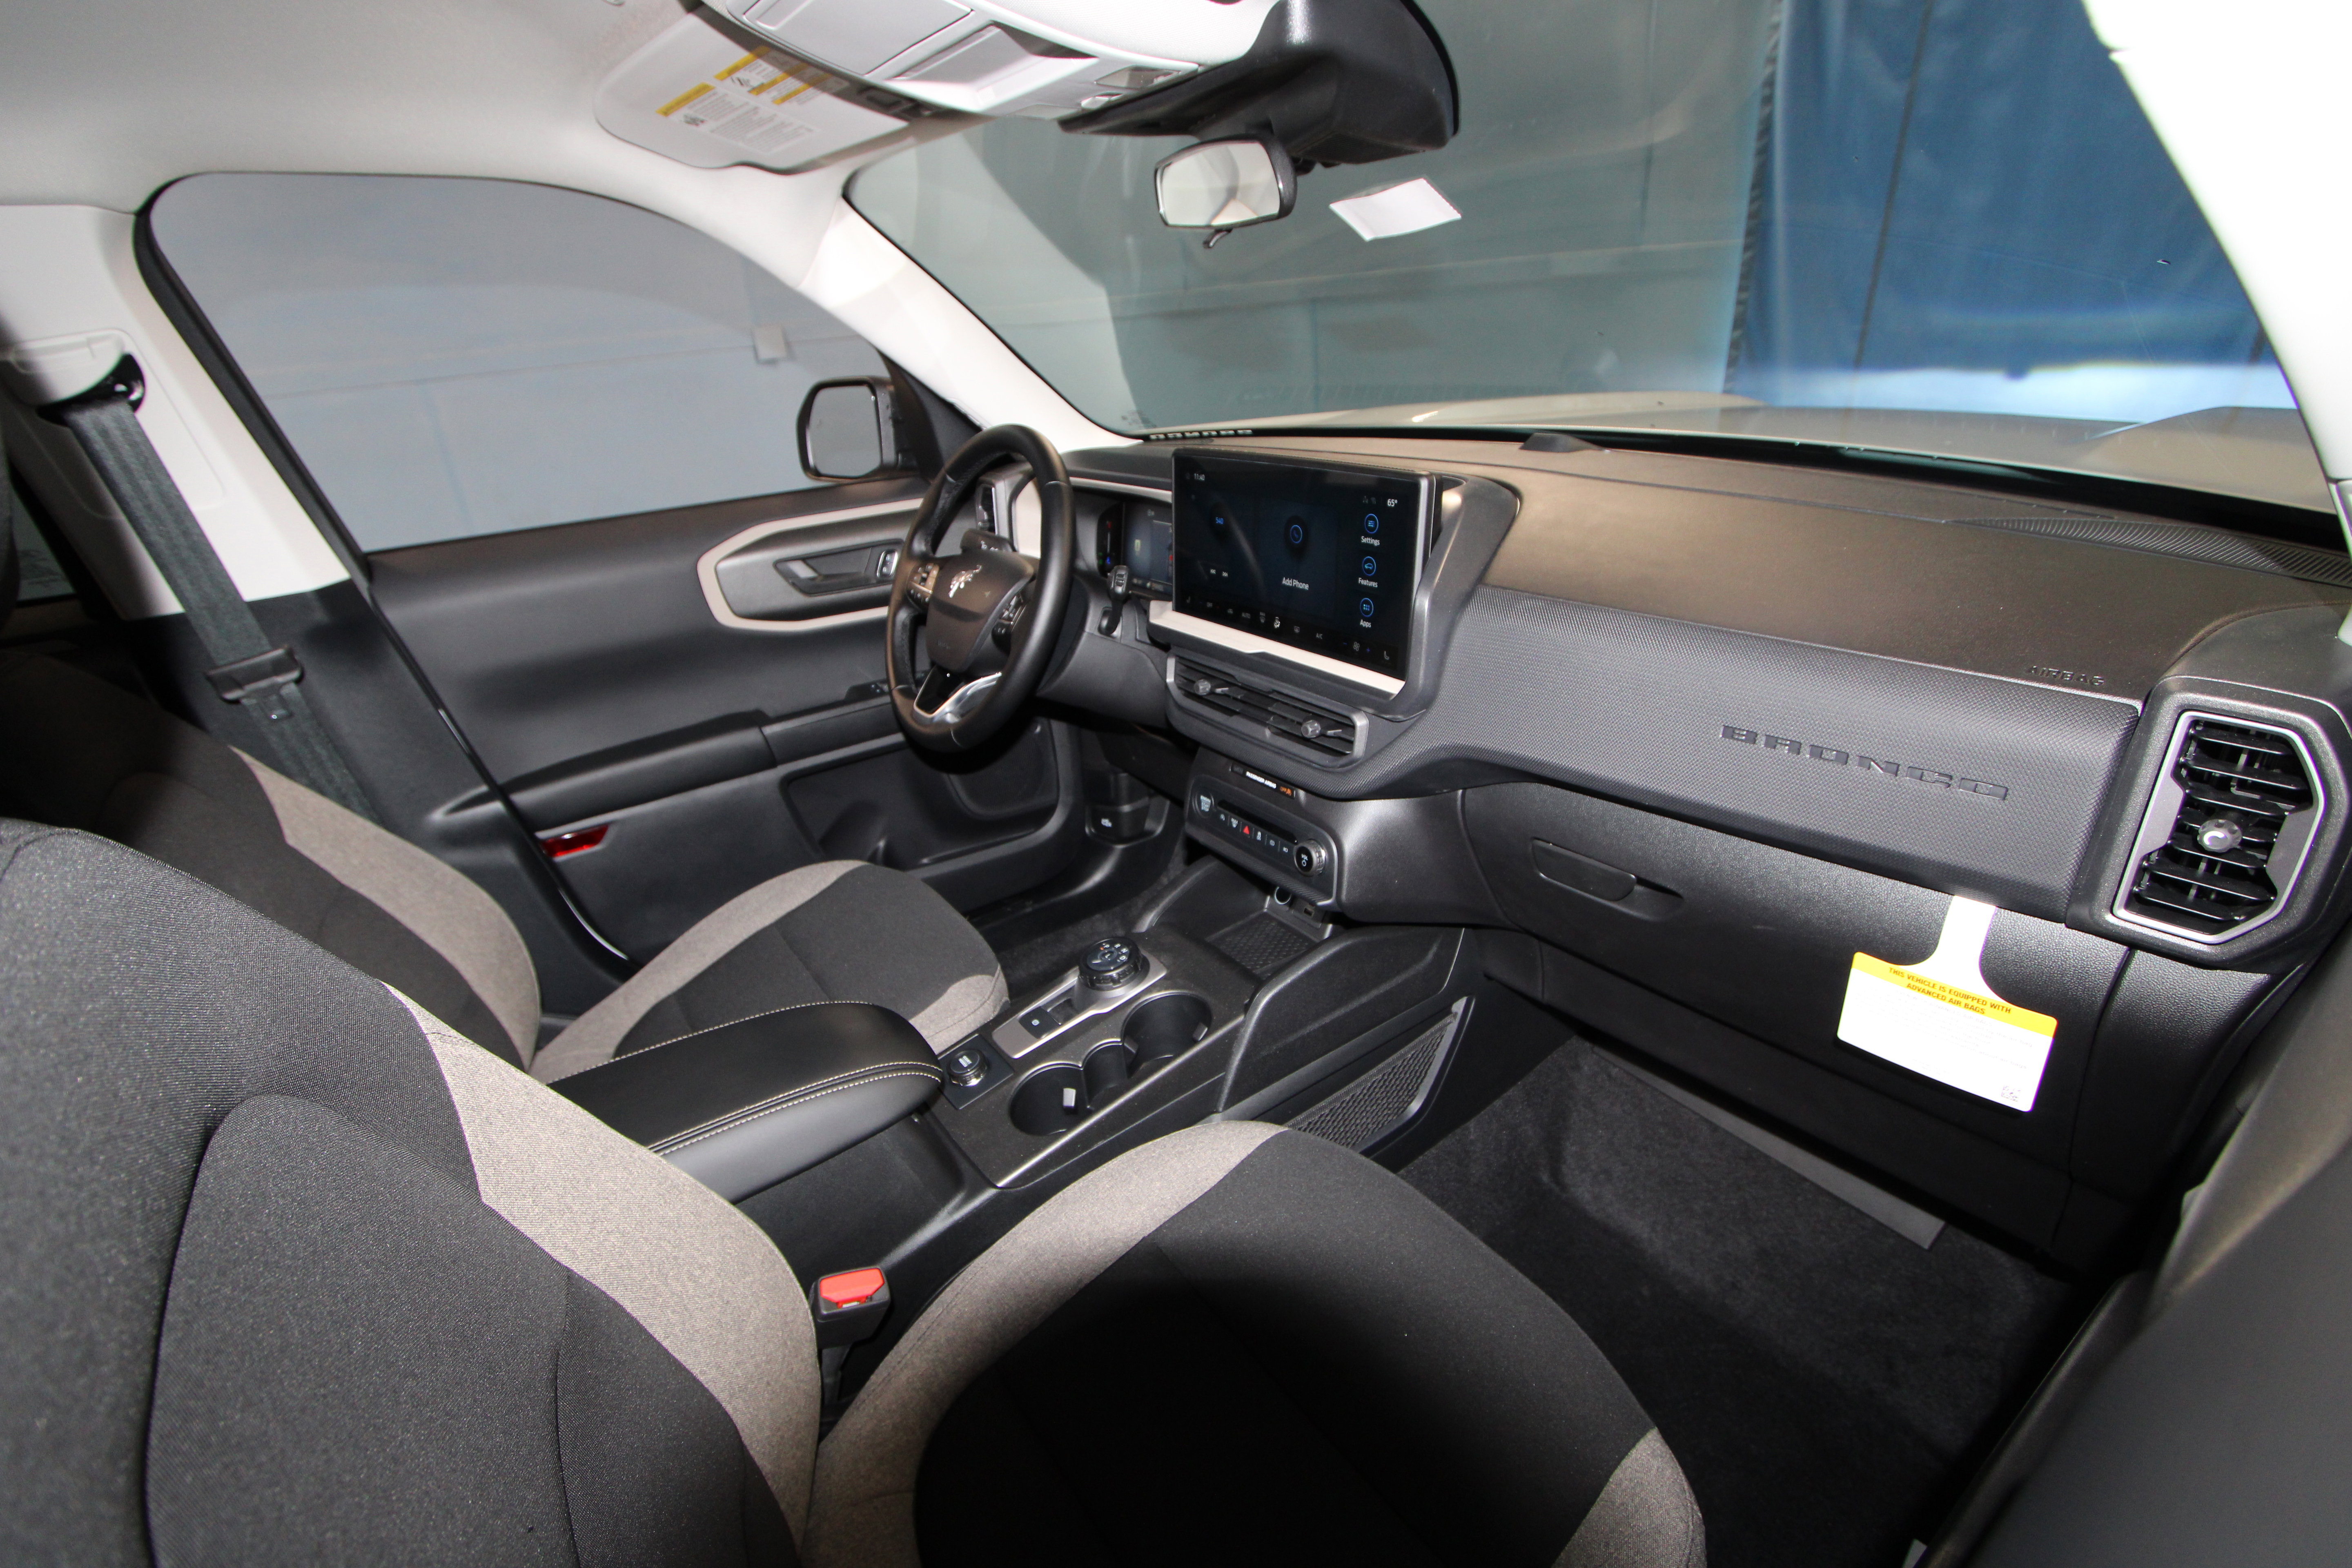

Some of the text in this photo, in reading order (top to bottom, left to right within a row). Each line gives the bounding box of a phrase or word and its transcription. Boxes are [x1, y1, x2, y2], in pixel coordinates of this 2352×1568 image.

[1361, 536, 1380, 546] Settings
[1282, 577, 1309, 590] Add Phone
[1358, 577, 1378, 587] Features
[1360, 619, 1371, 628] Apps
[2026, 666, 2105, 686] AIRBAG
[1721, 725, 2009, 801] BRONCO
[1889, 967, 1904, 978] THIS
[1907, 974, 1937, 989] VEHICLE
[1949, 989, 1987, 1006] EQUIPPED
[1990, 1002, 2011, 1013] WITH
[1907, 983, 1985, 1014] ADVANCED AIR BAGS
